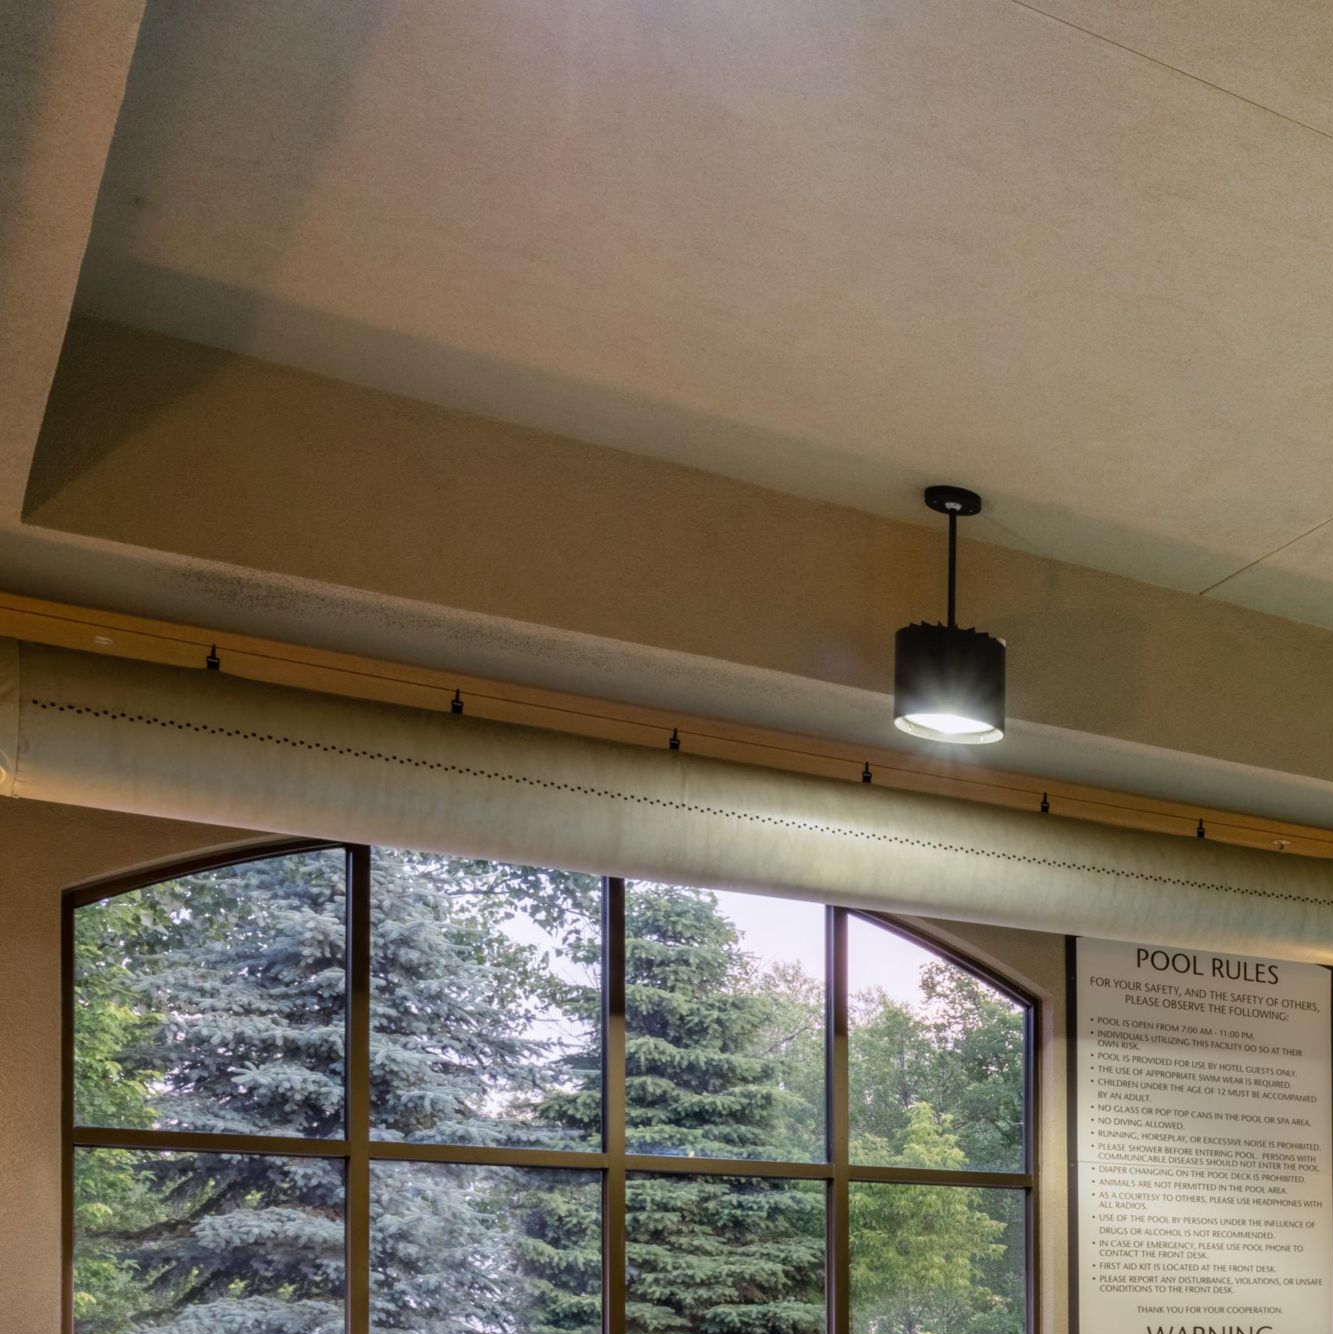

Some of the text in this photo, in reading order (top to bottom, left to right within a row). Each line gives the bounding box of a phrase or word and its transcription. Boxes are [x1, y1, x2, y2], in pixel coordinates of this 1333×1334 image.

[1136, 947, 1279, 985] POOL RULES
[1090, 976, 1320, 1012] FOR YOUR SAFETY, AND THE SAFETY OF OTHERS,
[1125, 994, 1290, 1022] PLEASE OBSERVE THE FOLLOWING:
[1097, 1016, 1119, 1027] POOL
[1122, 1019, 1130, 1028] IS
[1131, 1020, 1154, 1030] OPEN
[1156, 1022, 1179, 1033] FROM
[1182, 1025, 1198, 1034] 7:00
[1200, 1027, 1213, 1036] AM
[1220, 1029, 1240, 1039] 11:00
[1097, 1029, 1303, 1057] INDIVIDUALS UTILIZING THIS FACILITY DO SO AT THEIR
[1097, 1039, 1119, 1048] OWN
[1097, 1052, 1120, 1062] POOL
[1122, 1054, 1130, 1063] IS
[1132, 1055, 1172, 1066] PROVIDED
[1174, 1059, 1190, 1068] FOR
[1191, 1061, 1206, 1069] USE
[1208, 1062, 1217, 1070] BY
[1219, 1063, 1243, 1073] HOTEL
[1245, 1065, 1274, 1076] GUESTS
[1098, 1065, 1113, 1074] THE
[1115, 1066, 1130, 1075] USE
[1132, 1068, 1143, 1076] OF
[1146, 1069, 1196, 1081] APPROPRIATE
[1199, 1074, 1221, 1083] SWIM
[1222, 1076, 1244, 1085] WEAR
[1245, 1078, 1252, 1086] IS
[1097, 1078, 1317, 1103] CHILDREN UNDER THE AGE OF 12 MUST BE ACCOMPANIED
[1097, 1091, 1107, 1099] BY
[1110, 1092, 1122, 1100] AN
[1097, 1104, 1112, 1112] NO
[1113, 1105, 1139, 1114] GLASS
[1141, 1107, 1153, 1115] OR
[1155, 1108, 1171, 1117] POP
[1174, 1109, 1189, 1118] TOP
[1191, 1111, 1212, 1120] CANS
[1214, 1112, 1223, 1120] IN
[1225, 1113, 1239, 1121] THE
[1241, 1114, 1261, 1123] POOL
[1264, 1116, 1275, 1124] OR
[1277, 1117, 1290, 1125] SPA
[1097, 1116, 1112, 1125] NO
[1113, 1118, 1143, 1127] DIVING
[1190, 1135, 1201, 1144] OR
[1203, 1136, 1242, 1146] EXCESSIVE
[1243, 1139, 1267, 1148] NOISE
[1097, 1142, 1125, 1152] PLEASE
[1128, 1144, 1163, 1154] SHOWER
[1164, 1146, 1193, 1156] BEFORE
[1195, 1148, 1233, 1158] ENTERING
[1262, 1152, 1295, 1162] PERSONS
[1297, 1154, 1317, 1163] WITH
[1098, 1152, 1166, 1163] COMMUNICABLE
[1168, 1156, 1204, 1166] DISEASES
[1205, 1158, 1238, 1168] SHOULD
[1240, 1160, 1256, 1168] NOT
[1258, 1161, 1281, 1170] ENTER
[1283, 1163, 1296, 1171] THE
[1098, 1165, 1127, 1174] DIAPER
[1129, 1167, 1174, 1177] CHANGING
[1175, 1169, 1189, 1177] ON
[1191, 1170, 1205, 1178] THE
[1207, 1171, 1228, 1179] POOL
[1231, 1172, 1251, 1181] DECK
[1253, 1173, 1260, 1181] IS
[1099, 1262, 1120, 1270] FIRST
[1123, 1262, 1137, 1270] AID
[1139, 1263, 1151, 1271] KIT
[1153, 1263, 1160, 1271] IS
[1162, 1263, 1199, 1271] LOCATED
[1201, 1264, 1210, 1272] AT
[1213, 1264, 1227, 1272] THE
[1229, 1265, 1254, 1273] FRONT
[1099, 1275, 1127, 1283] PLEASE
[1129, 1275, 1158, 1283] REPORT
[1160, 1276, 1176, 1284] ANY
[1295, 1278, 1323, 1286] UNSAFE
[1099, 1284, 1153, 1293] CONDITIONS
[1155, 1285, 1166, 1293] TO
[1168, 1285, 1183, 1293] THE
[1185, 1285, 1211, 1293] FRONT
[1166, 1306, 1184, 1314] YOU
[1185, 1306, 1201, 1314] FOR
[1203, 1306, 1225, 1314] YOUR
